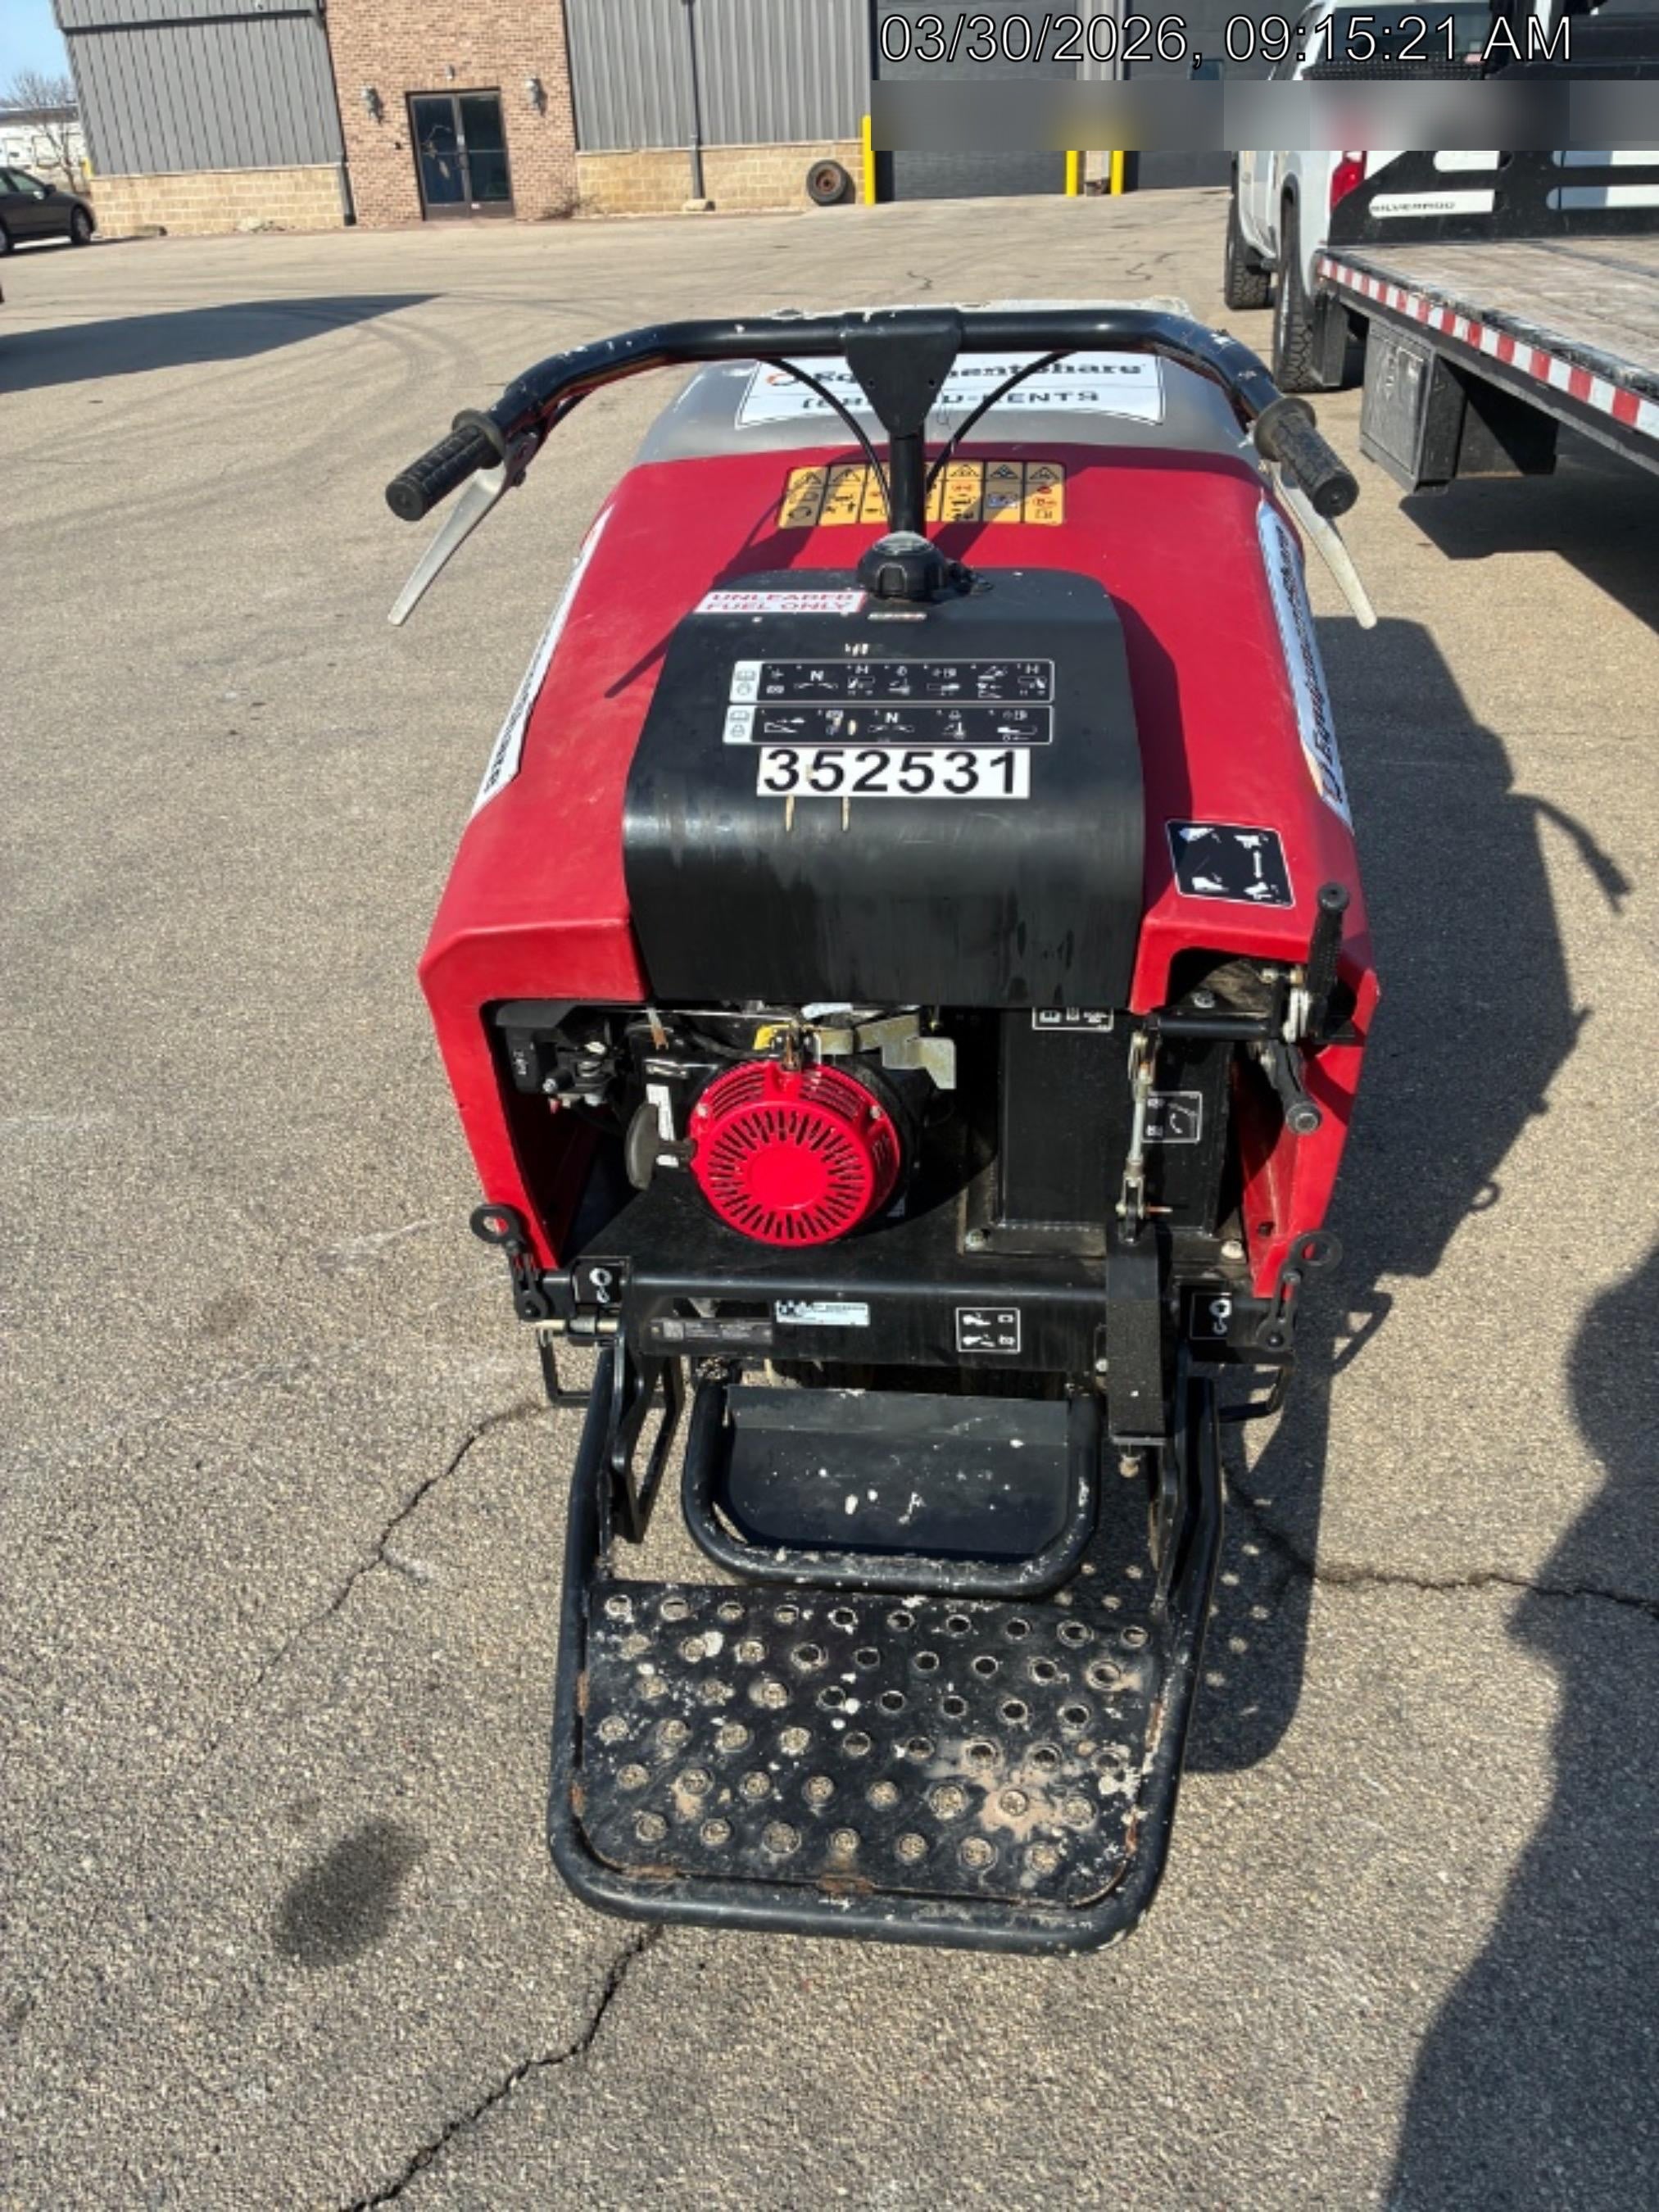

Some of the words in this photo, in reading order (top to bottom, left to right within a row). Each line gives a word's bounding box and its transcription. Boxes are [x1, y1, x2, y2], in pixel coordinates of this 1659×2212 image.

[706, 601, 769, 610] FUEL
[781, 601, 850, 610] ONLY
[764, 748, 1016, 795] 352531
